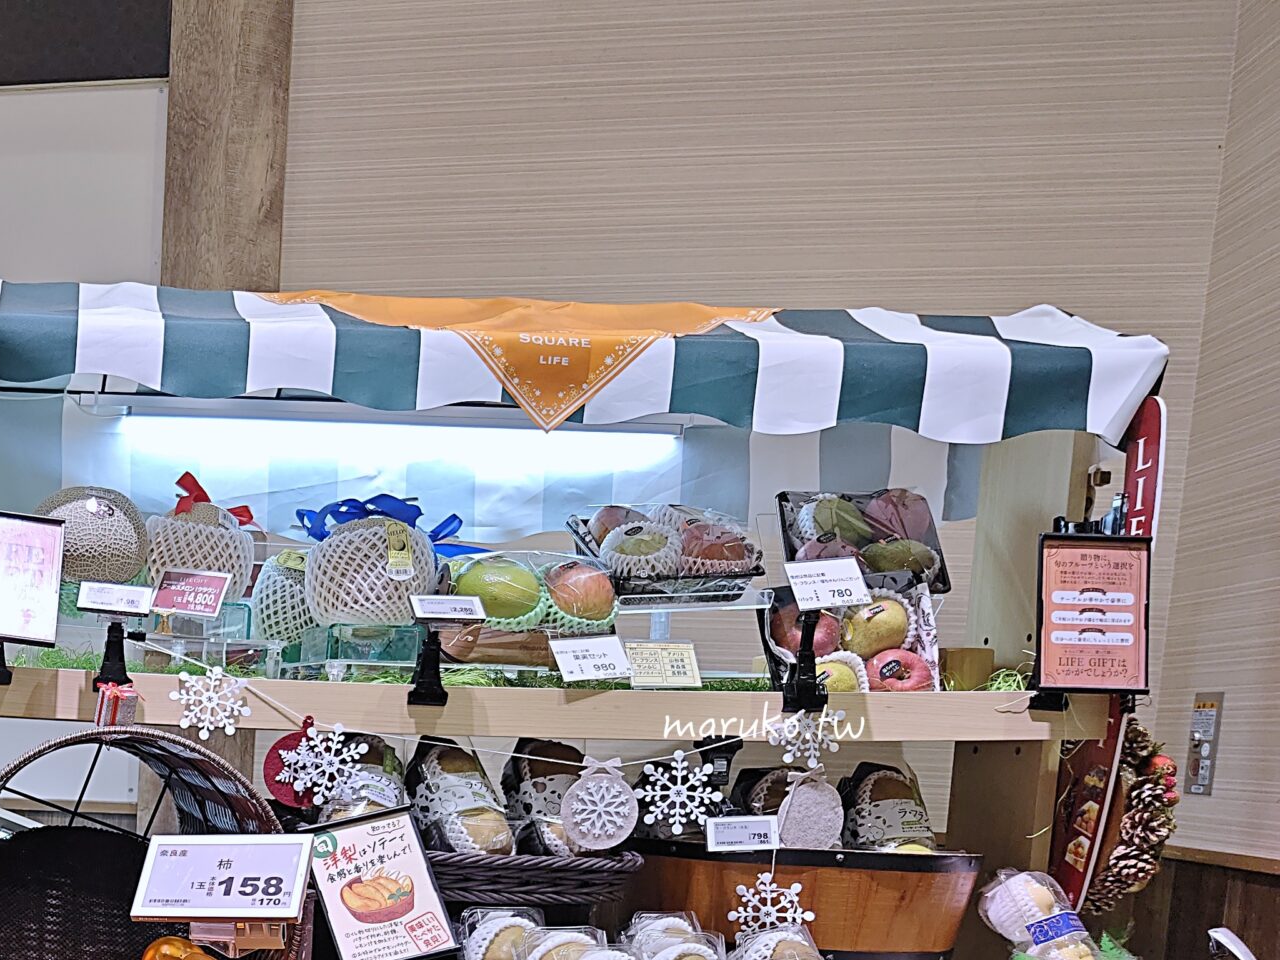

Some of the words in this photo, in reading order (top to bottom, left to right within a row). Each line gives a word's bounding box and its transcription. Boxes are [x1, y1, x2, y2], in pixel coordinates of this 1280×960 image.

[519, 333, 591, 348] SQUARE
[539, 355, 569, 366] LIFE
[187, 592, 215, 606] 4,800
[828, 588, 853, 599] 780
[593, 663, 617, 672] 980
[1058, 657, 1085, 667] LIFE
[370, 820, 401, 832] 知ってる?
[751, 832, 769, 840] 798
[160, 849, 188, 857] 奈良産
[216, 858, 234, 871] 柿
[218, 876, 284, 897] 158
[258, 898, 281, 906] 170
